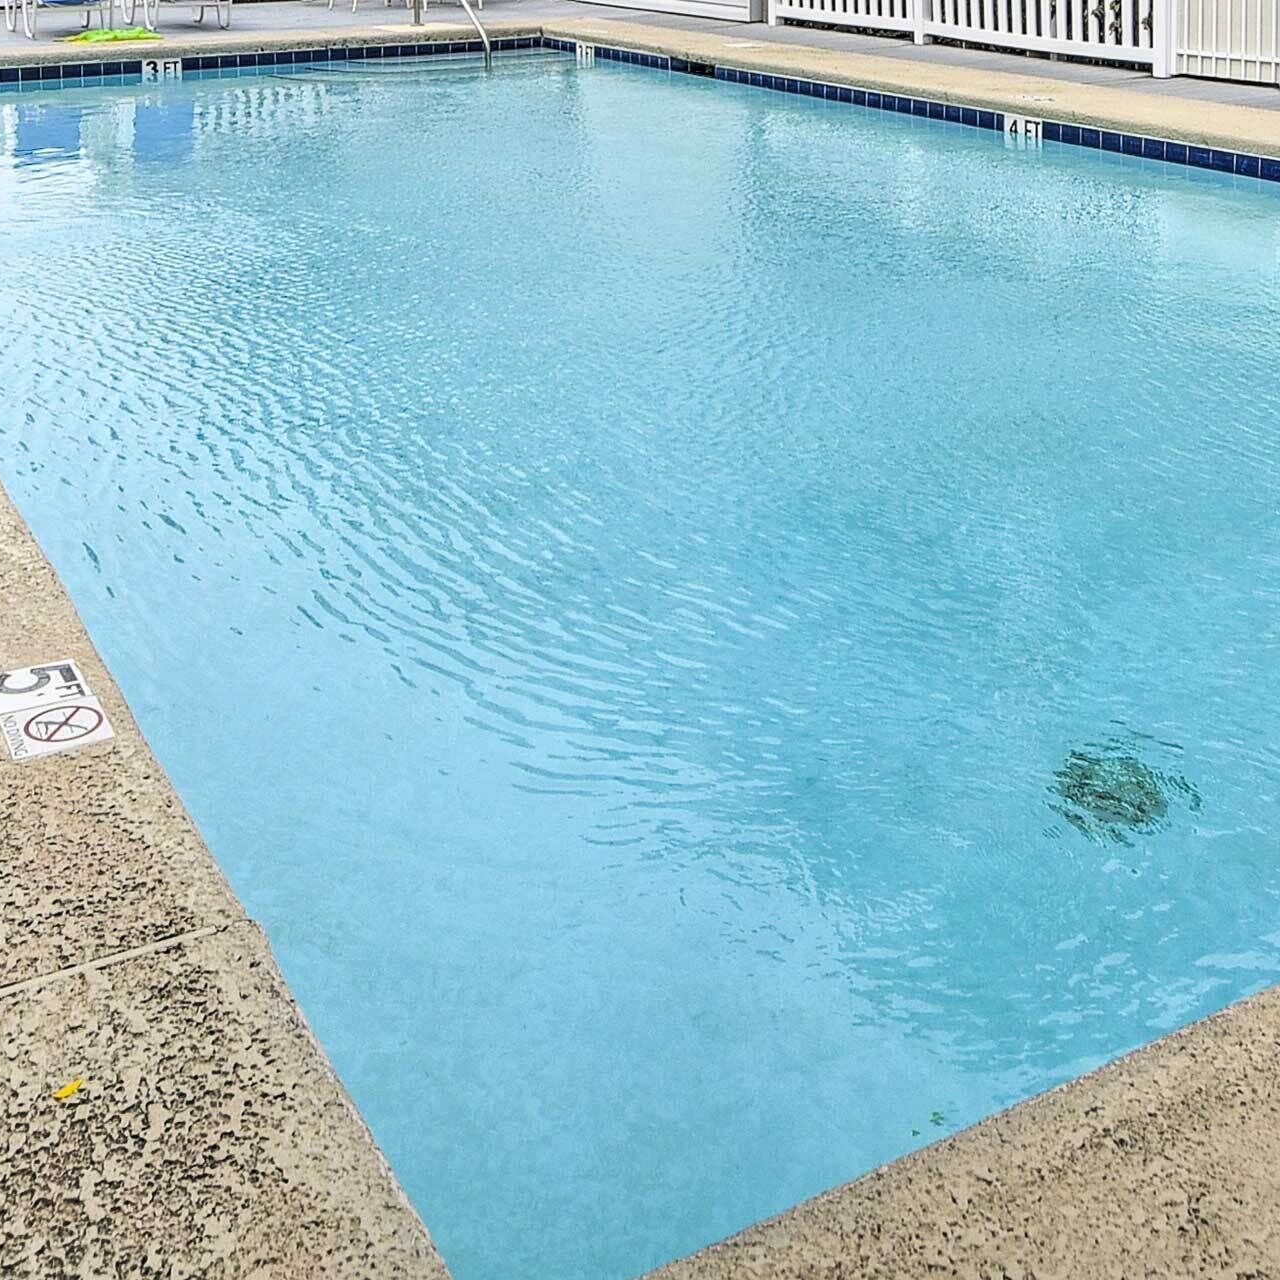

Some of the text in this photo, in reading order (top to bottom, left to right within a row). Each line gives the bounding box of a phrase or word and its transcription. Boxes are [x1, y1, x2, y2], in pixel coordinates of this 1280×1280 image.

[145, 60, 180, 75] 3 FT
[1009, 120, 1040, 138] 4 FT
[55, 683, 86, 698] FT
[2, 715, 28, 756] NO DIVING
